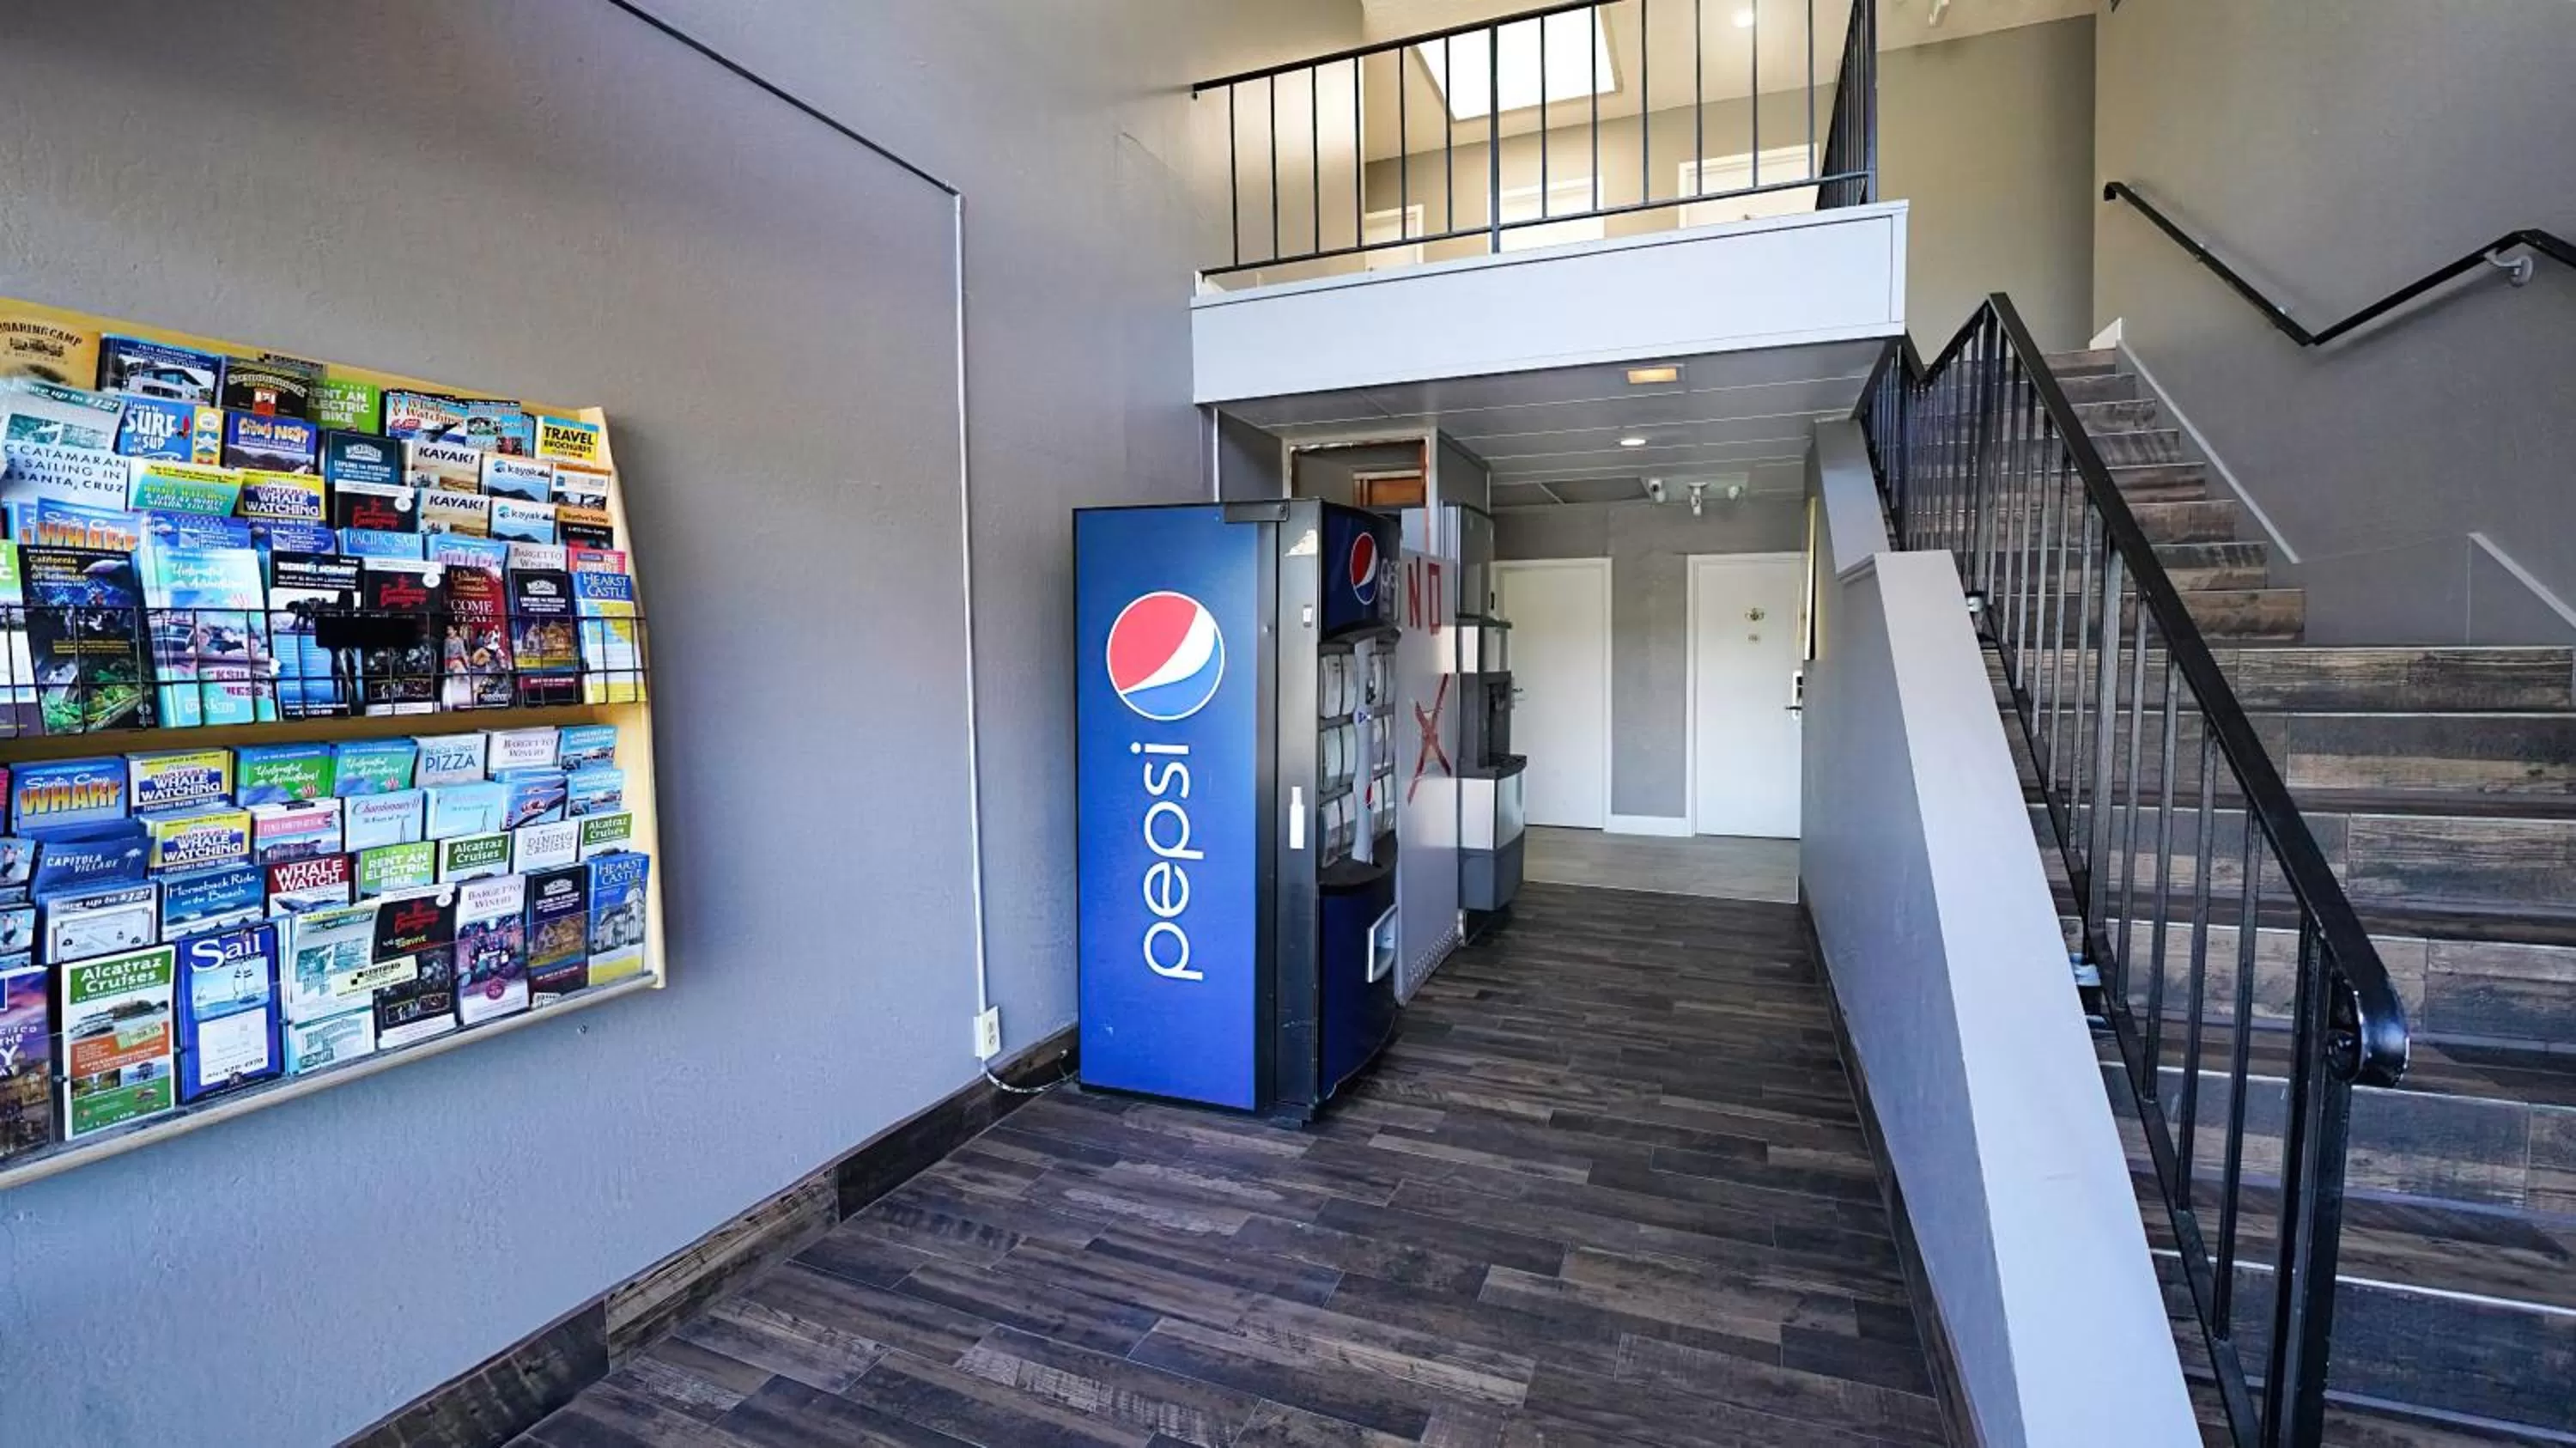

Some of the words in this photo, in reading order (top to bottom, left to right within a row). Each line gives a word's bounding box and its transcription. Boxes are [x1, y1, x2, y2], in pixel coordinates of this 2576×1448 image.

[125, 409, 177, 438] SURF
[320, 411, 355, 423] BIKE
[143, 435, 165, 450] SUP
[544, 426, 594, 446] TRAVEL
[20, 444, 127, 469] CATAMARAN
[418, 446, 475, 465] KAYAK!
[25, 457, 94, 478] SAILING
[102, 470, 121, 481] IN
[82, 479, 125, 493] CRUZ
[258, 491, 308, 506] WHALE
[428, 494, 483, 512] KAYAK!
[246, 501, 319, 516] WATCHING
[28, 555, 77, 565] California
[30, 563, 78, 574] Academy
[32, 571, 42, 580] of
[45, 571, 87, 582] Sciences
[583, 573, 627, 587] HEARST
[586, 584, 627, 598] CASTLE
[1407, 556, 1442, 636] NO
[451, 599, 494, 615] COME
[425, 753, 477, 774] PIZZA
[24, 776, 70, 789] Santa
[154, 775, 210, 790] WHALE
[20, 781, 123, 816] WHARF
[140, 782, 221, 802] WATCHING
[588, 815, 628, 830] Alcatraz
[177, 834, 231, 849] WHALE
[526, 834, 574, 848] DINING
[590, 827, 624, 840] Cruises
[163, 843, 242, 862] WATCHING
[453, 838, 504, 855] Alcatraz
[46, 853, 103, 867] CAPITOLA
[74, 858, 119, 873] VILLAGE
[368, 855, 404, 870] RENT
[407, 851, 428, 863] AN
[455, 850, 501, 864] Cruises
[1130, 741, 1204, 982] pepsi
[274, 858, 344, 883] WHALE
[365, 861, 429, 880] ELECTRIC
[598, 858, 644, 876] HEARST
[278, 871, 339, 892] WATCH
[601, 867, 643, 885] CASTLE
[168, 876, 229, 900] Horseback
[208, 885, 246, 902] Beach
[189, 932, 263, 973] Sail
[80, 955, 163, 983] Alcatraz
[84, 970, 157, 994] Cruises
